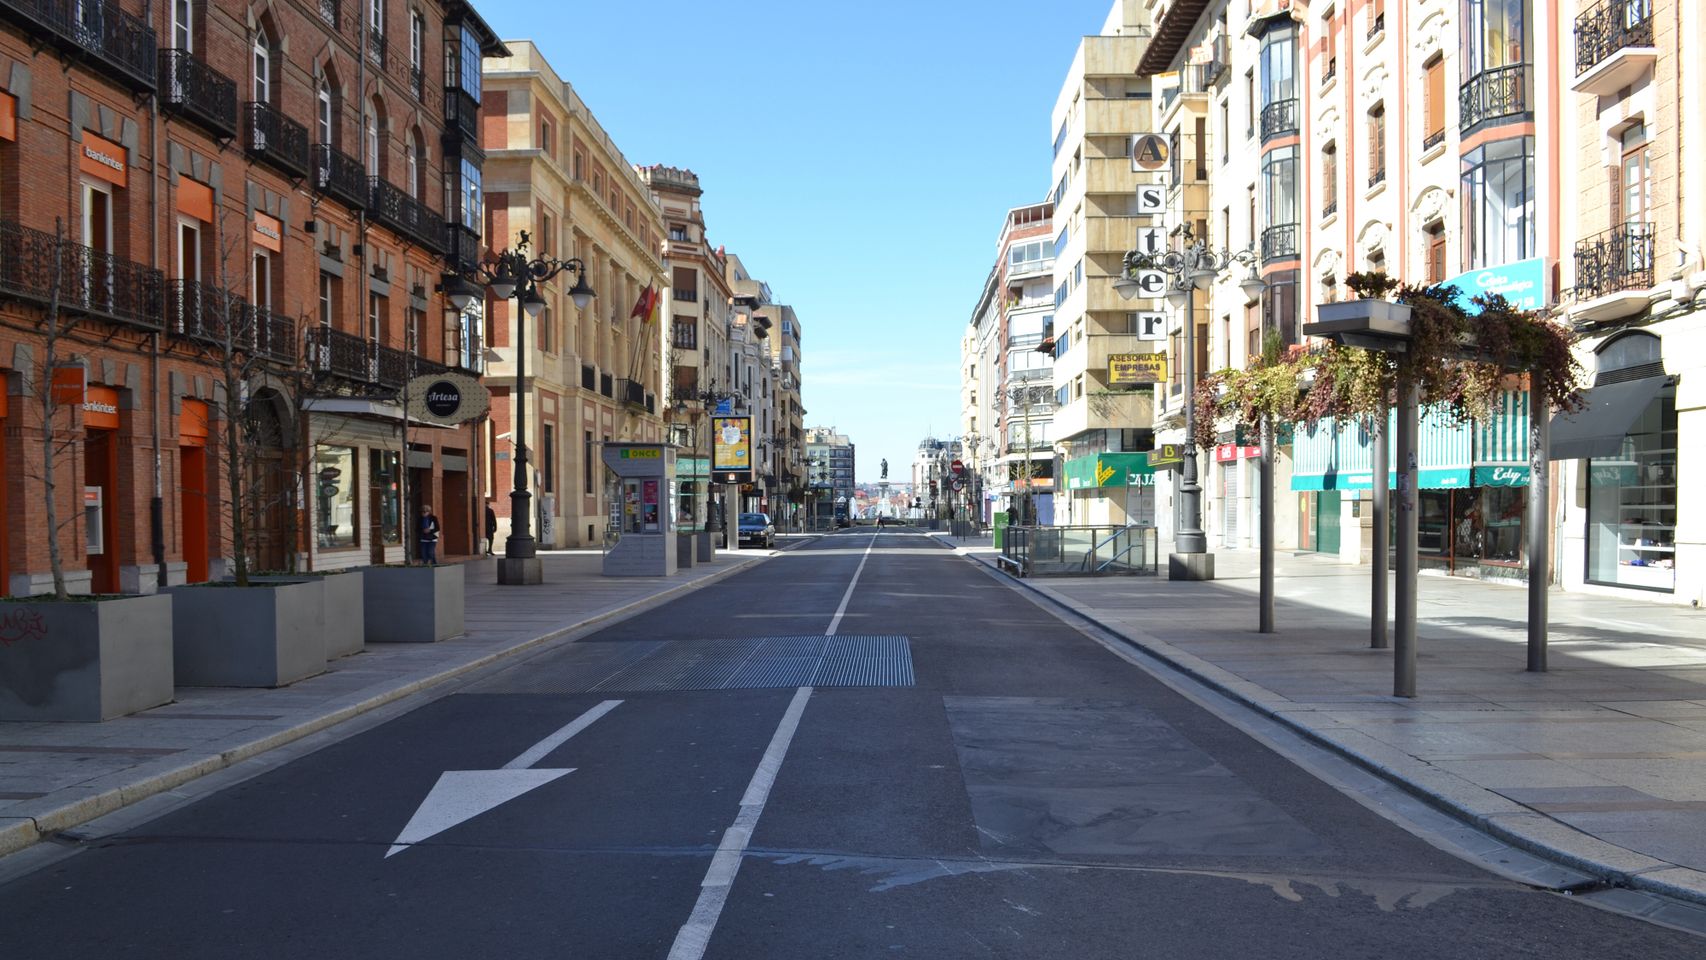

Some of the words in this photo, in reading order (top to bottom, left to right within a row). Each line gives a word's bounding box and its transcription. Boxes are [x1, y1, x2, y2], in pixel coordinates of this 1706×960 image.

[85, 146, 123, 171] bankinter
[1114, 363, 1161, 371] EMPRESAS
[428, 391, 459, 402] Artesa
[631, 449, 658, 457] ONCE
[1492, 467, 1521, 485] Edy
